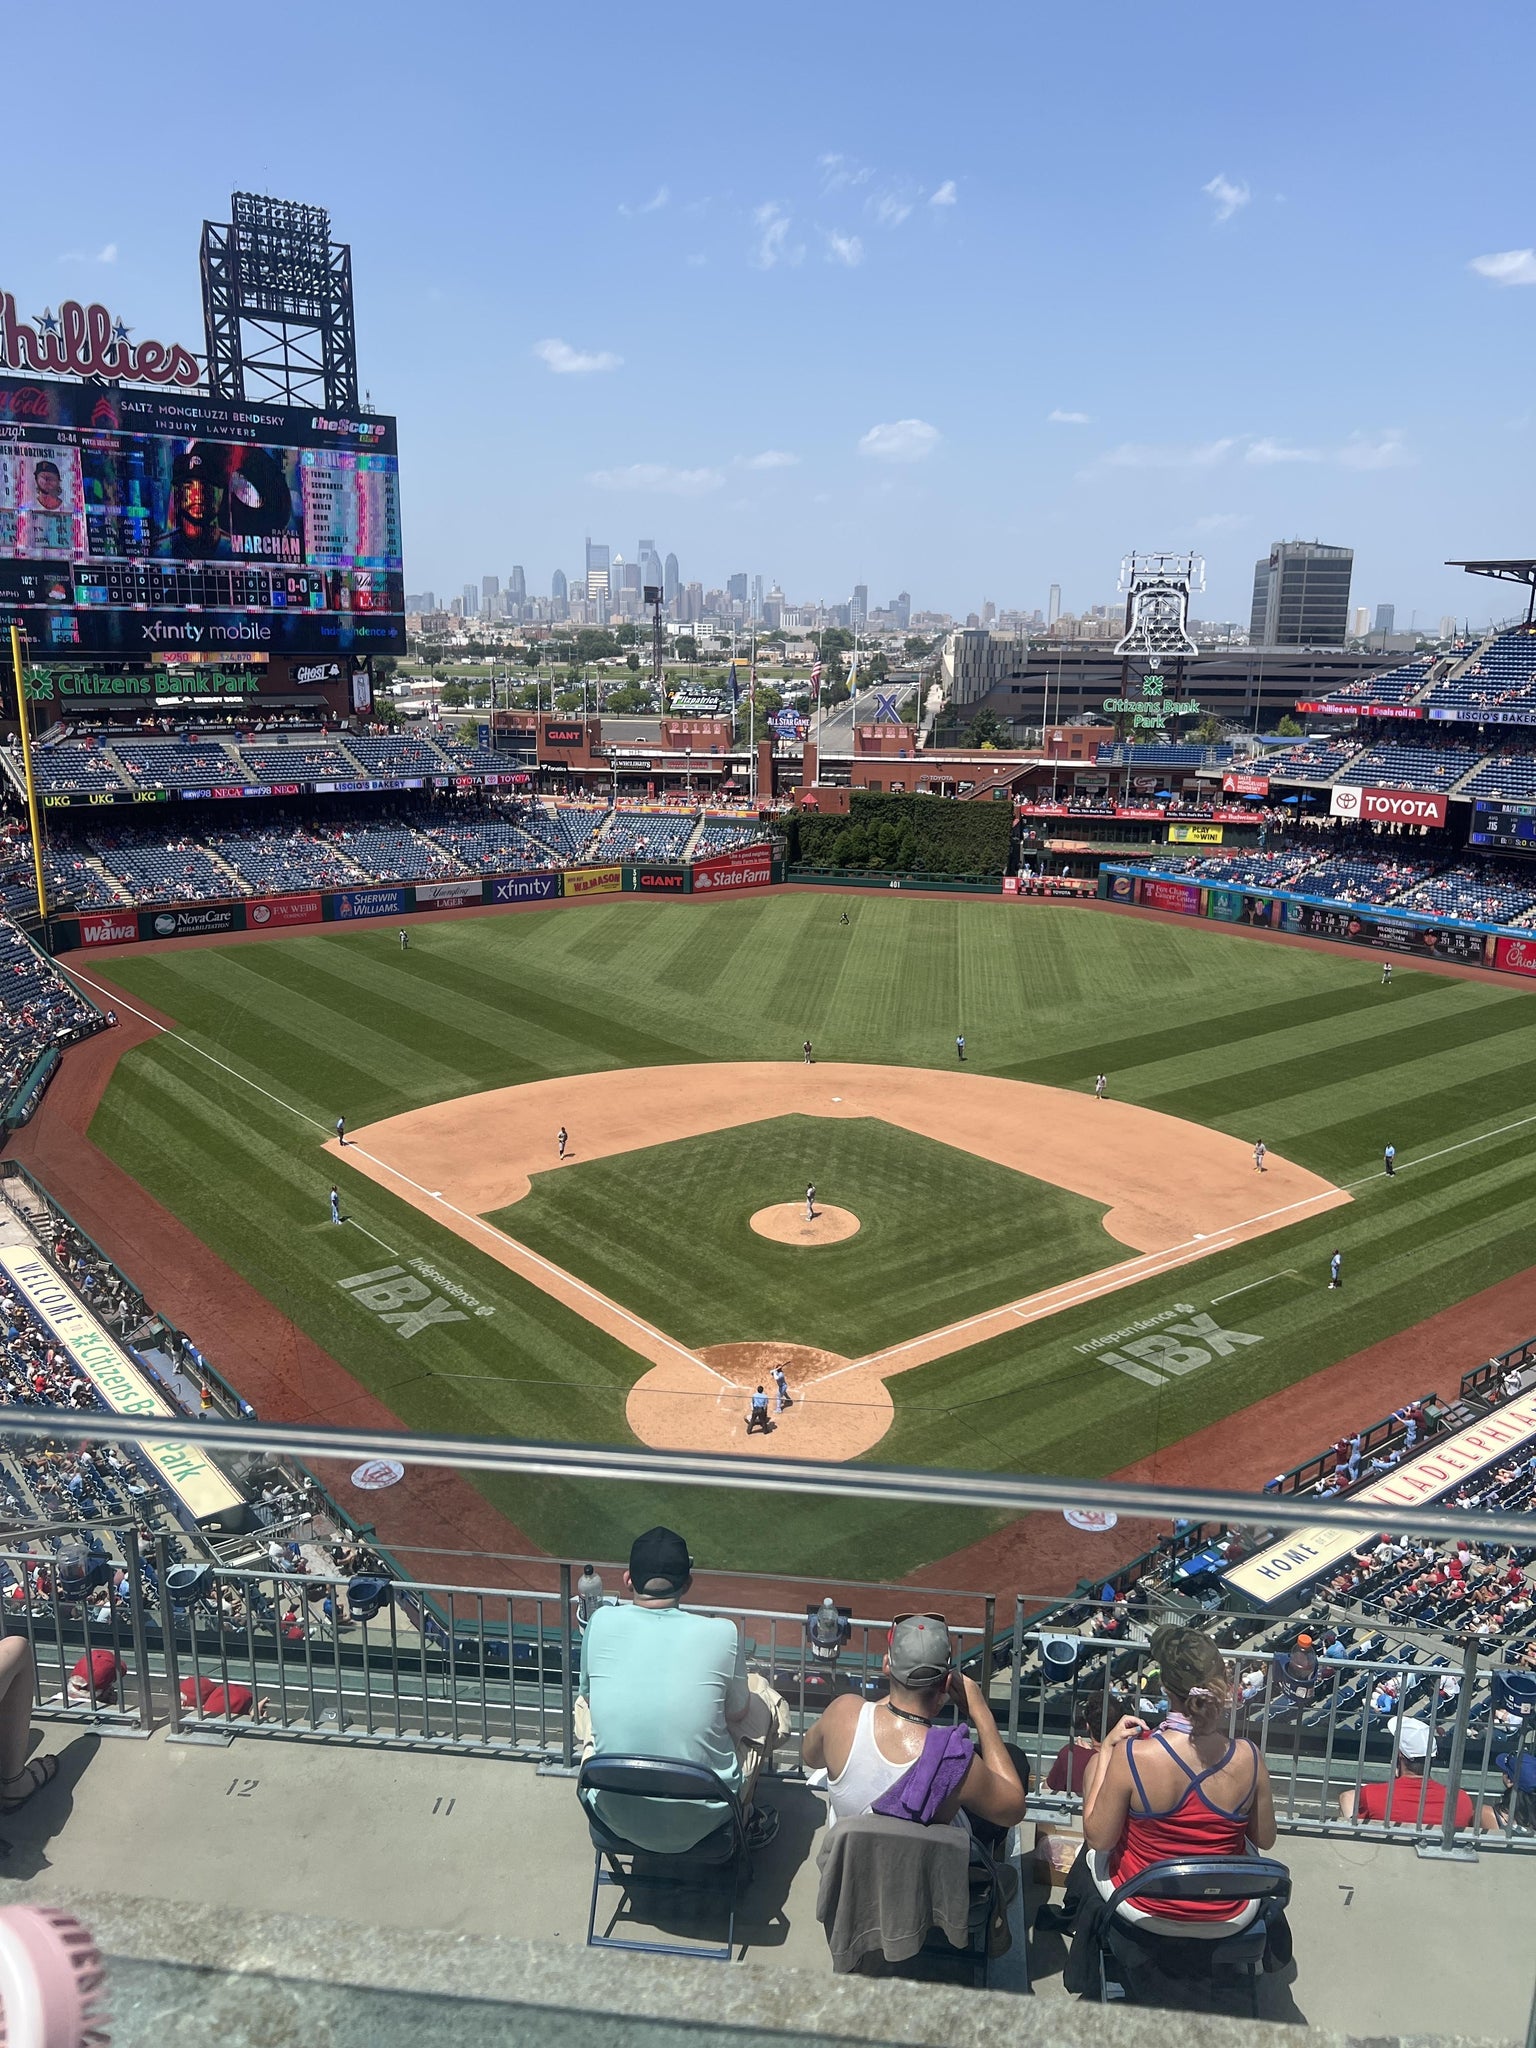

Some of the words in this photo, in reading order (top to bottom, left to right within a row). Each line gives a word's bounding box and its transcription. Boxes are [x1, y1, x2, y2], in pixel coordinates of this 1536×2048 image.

[0, 291, 200, 387] hillies
[121, 401, 153, 413] SALTZ
[159, 405, 228, 420] MONGELUZZI
[233, 412, 285, 426] BENDESKY
[155, 420, 197, 432] INJURY
[206, 425, 257, 437] LAWYERS
[81, 574, 99, 584] PIT
[141, 621, 204, 642] xfinity
[209, 622, 271, 640] mobile
[297, 663, 332, 685] GHOST
[58, 673, 151, 695] Citizens
[154, 672, 210, 694] Bank
[212, 671, 260, 693] Park
[1103, 698, 1162, 714] Citizens
[1163, 699, 1200, 714] Bank
[1317, 704, 1343, 713] Phillies
[1344, 706, 1357, 714] win
[1394, 708, 1408, 717] roll
[1409, 709, 1416, 718] in
[1134, 714, 1166, 729] Park
[1457, 711, 1499, 721] LISCIO'S
[548, 731, 580, 740] GIANT
[334, 781, 370, 791] LISCIO'S
[372, 779, 406, 789] BAKERY
[451, 776, 483, 786] TOYOTA
[500, 774, 531, 783] TOYOTA
[45, 796, 71, 807] UKG
[89, 794, 114, 804] UKG
[133, 792, 156, 802] UKG
[214, 788, 241, 798] NECA
[273, 785, 299, 794] NECA
[1366, 796, 1439, 819] TOYOTA
[1200, 832, 1218, 841] WIN!
[641, 875, 683, 886] GIANT
[889, 880, 900, 888] 401
[496, 879, 551, 900] xfinity
[353, 892, 398, 905] SHERWIN
[436, 898, 464, 908] LAGER
[291, 904, 318, 912] WEBB
[176, 910, 231, 926] NovaCare
[84, 926, 136, 943] Wawa
[407, 1257, 480, 1308] Independence
[14, 1261, 83, 1324] WELCOME
[336, 1265, 471, 1340] IBX
[1073, 1309, 1178, 1354] Independence
[1096, 1312, 1265, 1387] IBX
[81, 1345, 132, 1402] Citizens
[1256, 1543, 1319, 1580] HOME
[225, 1778, 260, 1798] 12
[432, 1797, 456, 1816] 11
[1338, 1885, 1355, 1906] 7
